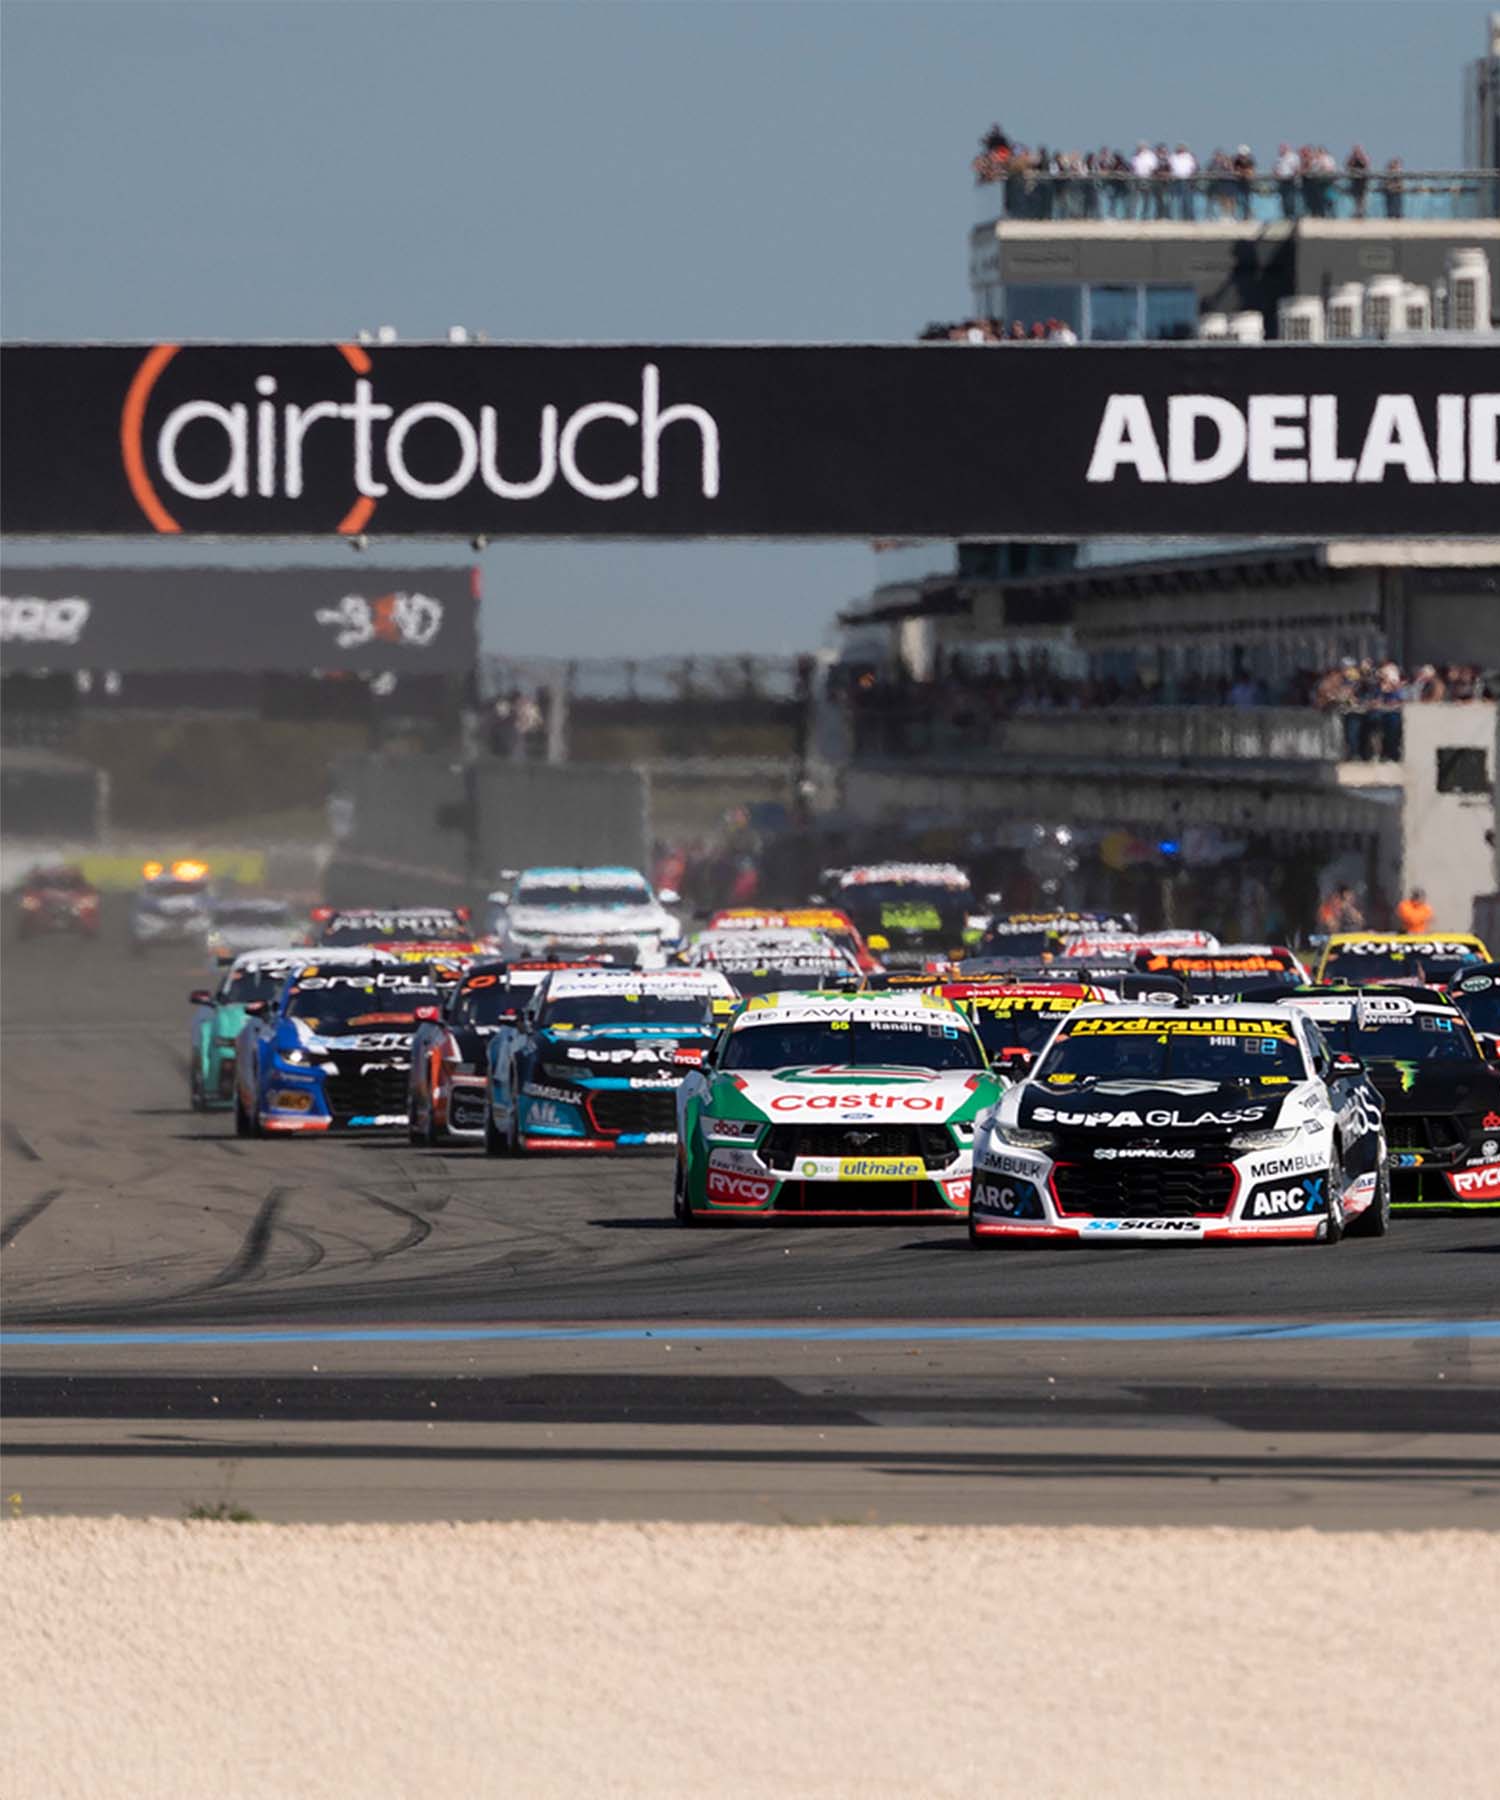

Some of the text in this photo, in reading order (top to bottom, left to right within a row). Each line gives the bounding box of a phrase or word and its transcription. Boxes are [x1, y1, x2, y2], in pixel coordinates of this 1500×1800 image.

[158, 363, 720, 500] airtouch
[859, 1008, 961, 1023] TRUCKS
[1072, 1018, 1289, 1036] Hydraulink
[1210, 1036, 1236, 1047] Hill
[567, 1047, 676, 1063] SUPAG
[770, 1092, 945, 1111] Castrol
[844, 1161, 919, 1176] ultimate
[709, 1172, 770, 1200] RYCO
